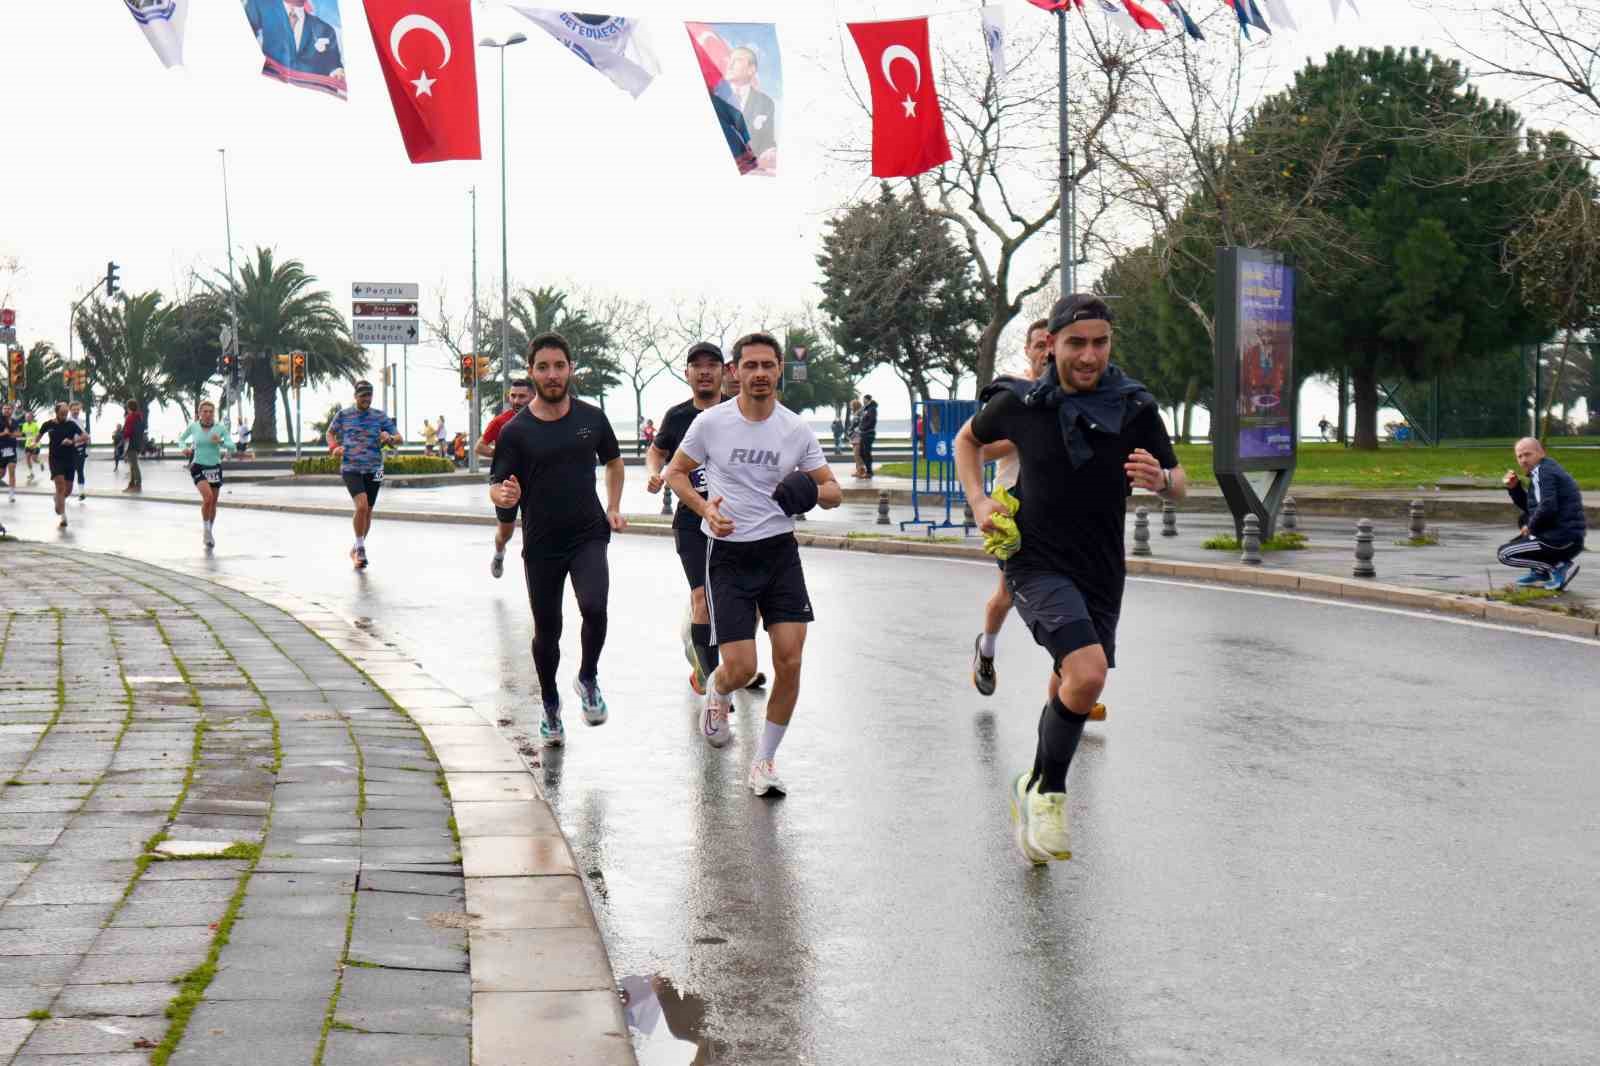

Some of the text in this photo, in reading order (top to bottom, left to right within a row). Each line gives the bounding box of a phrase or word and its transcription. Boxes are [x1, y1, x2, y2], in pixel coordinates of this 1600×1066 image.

[366, 287, 403, 295] Pendik
[357, 323, 403, 332] Maltepe
[730, 448, 781, 466] RUN
